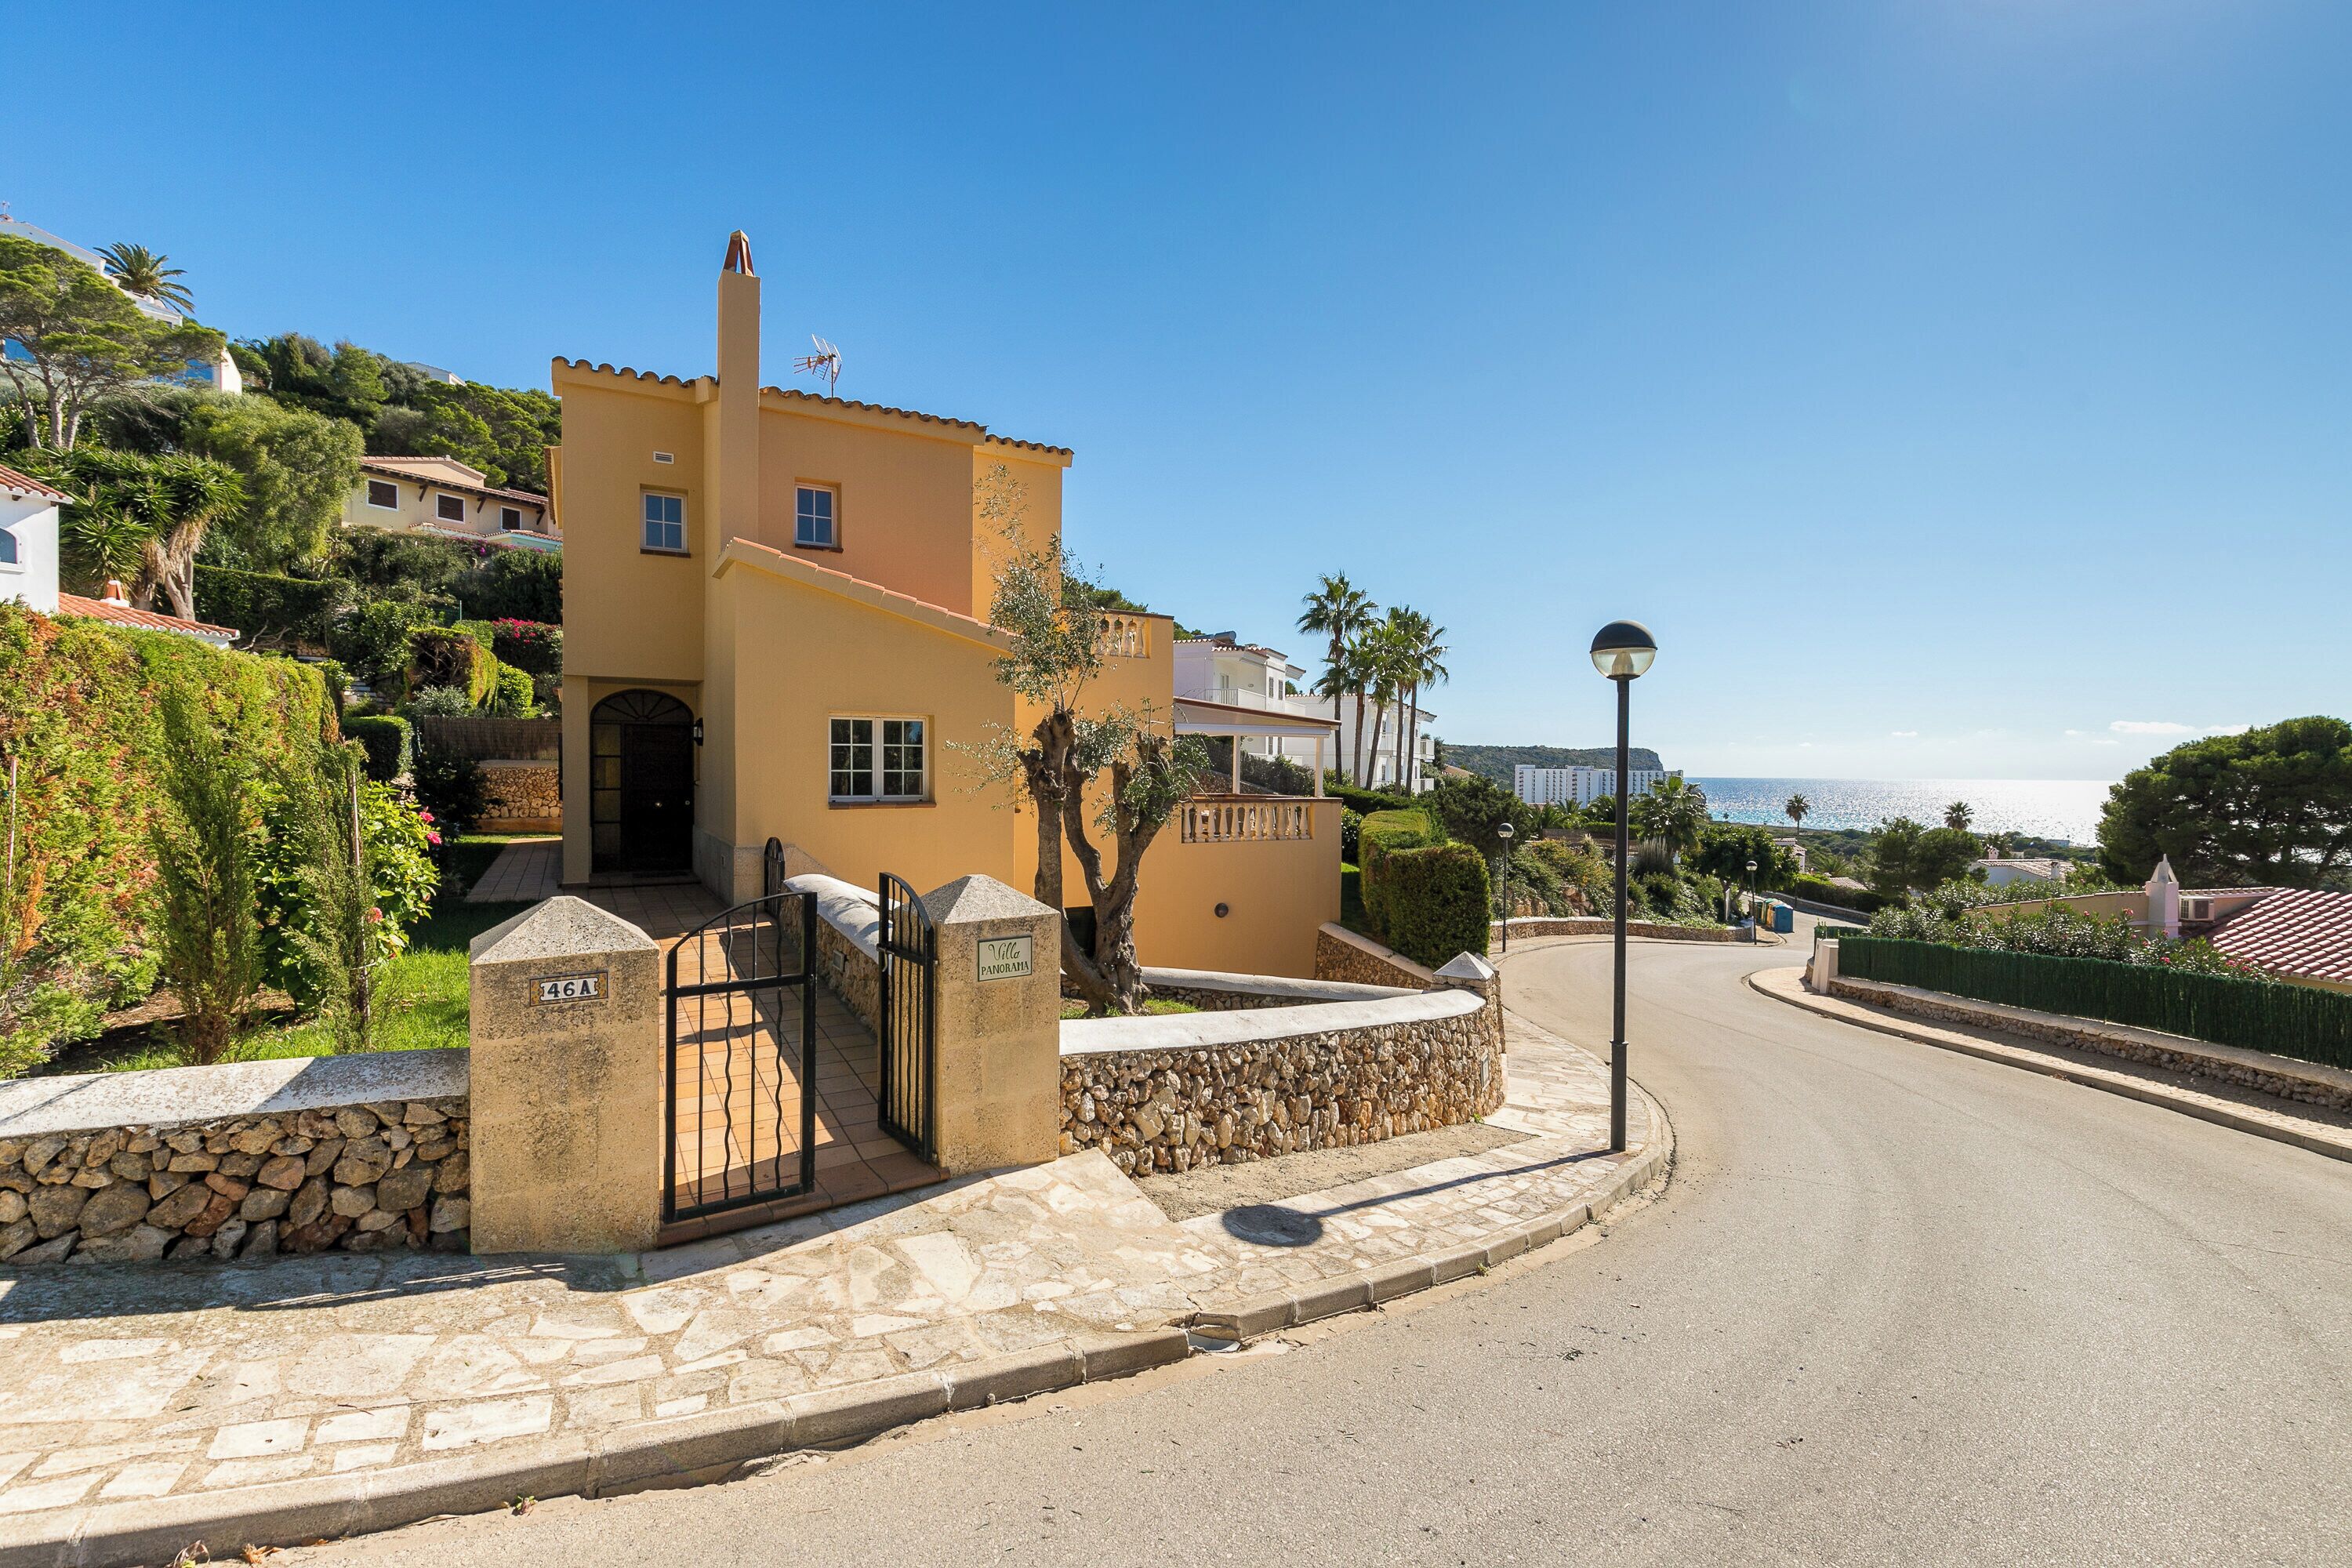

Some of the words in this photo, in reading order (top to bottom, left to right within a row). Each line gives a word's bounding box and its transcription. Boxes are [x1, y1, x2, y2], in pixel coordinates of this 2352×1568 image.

[988, 942, 1021, 960] Villa
[981, 961, 1029, 975] PANORAMA
[547, 980, 591, 998] 46A
